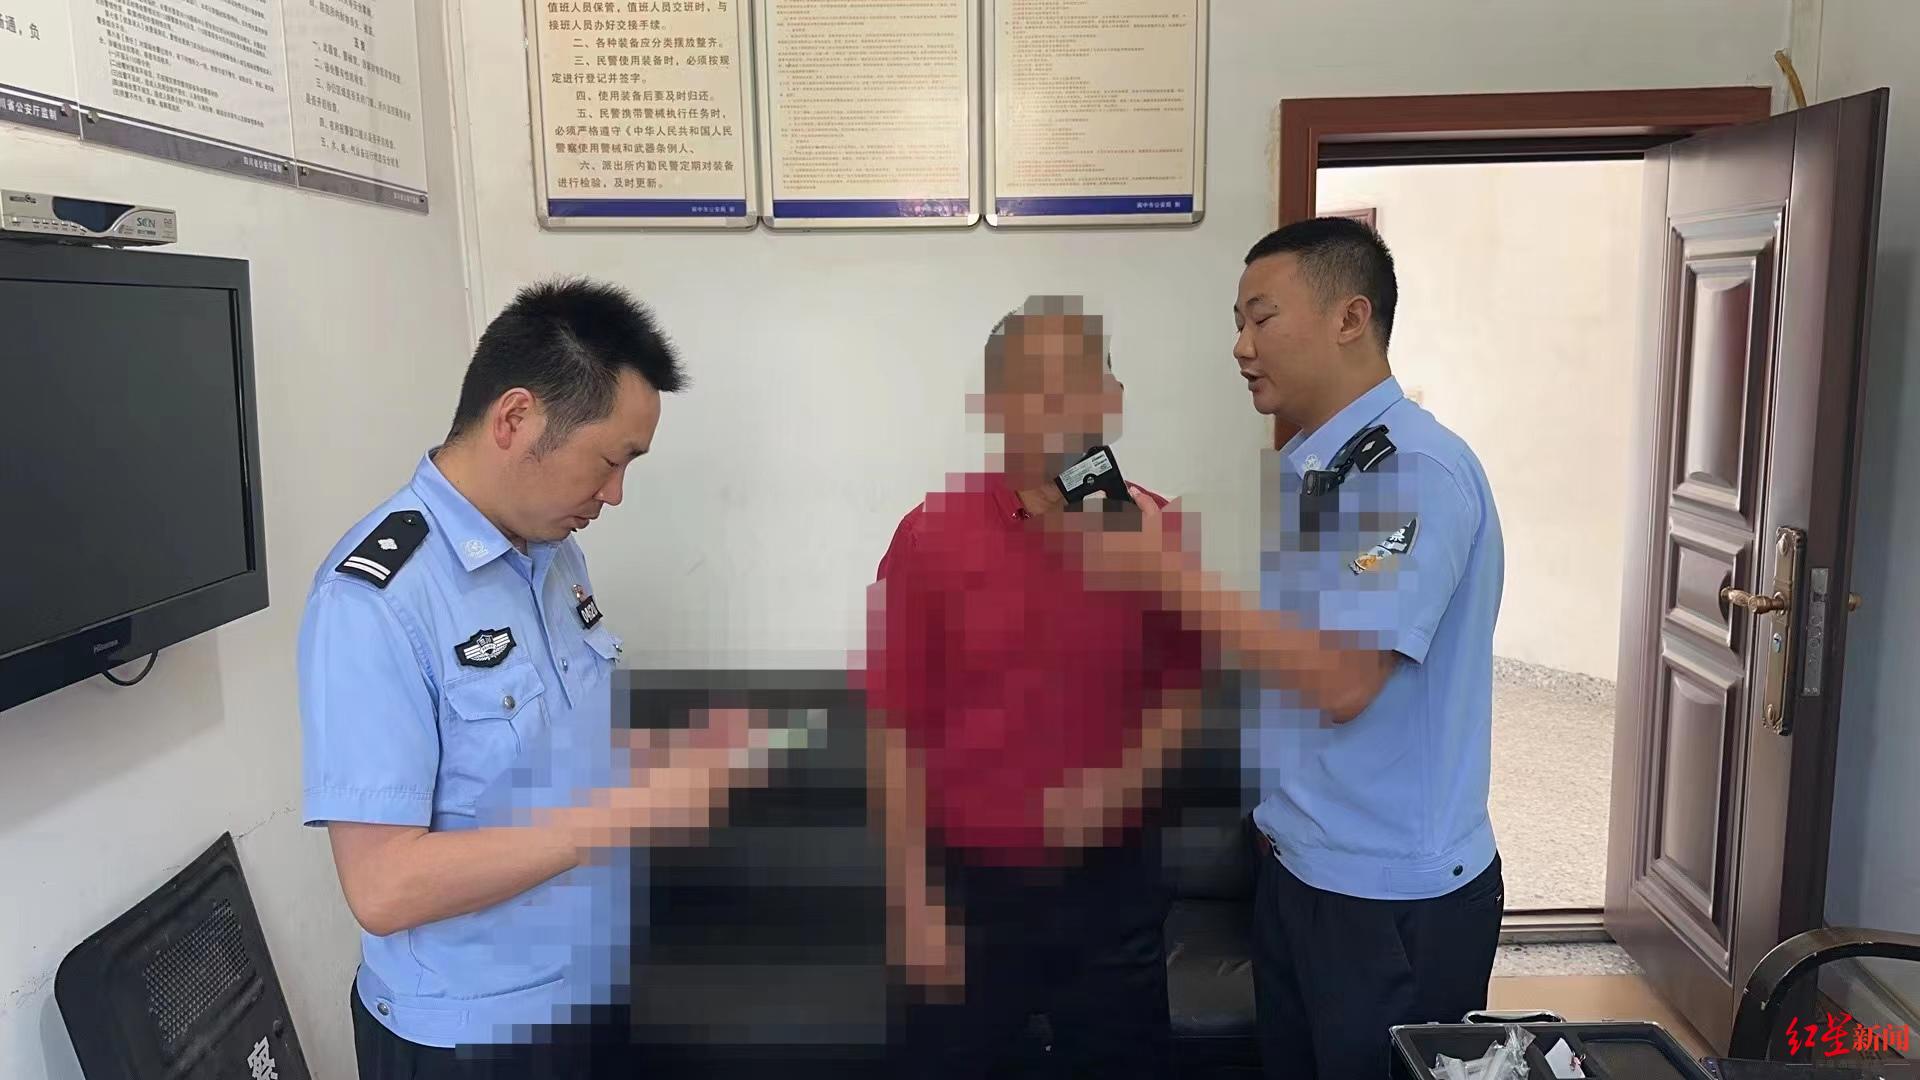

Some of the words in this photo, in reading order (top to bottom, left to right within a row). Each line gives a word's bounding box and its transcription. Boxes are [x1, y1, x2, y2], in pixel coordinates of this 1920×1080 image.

[549, 20, 667, 31] 接班人员办好交接手续。
[551, 73, 647, 84] 定进行登记并签字。
[575, 90, 715, 102] 四、使用装备后要及时归还。
[554, 125, 734, 137] 必须严格遵守《中华人民共和国人民
[579, 160, 735, 171] 六、派出所内勤民警定期对装备
